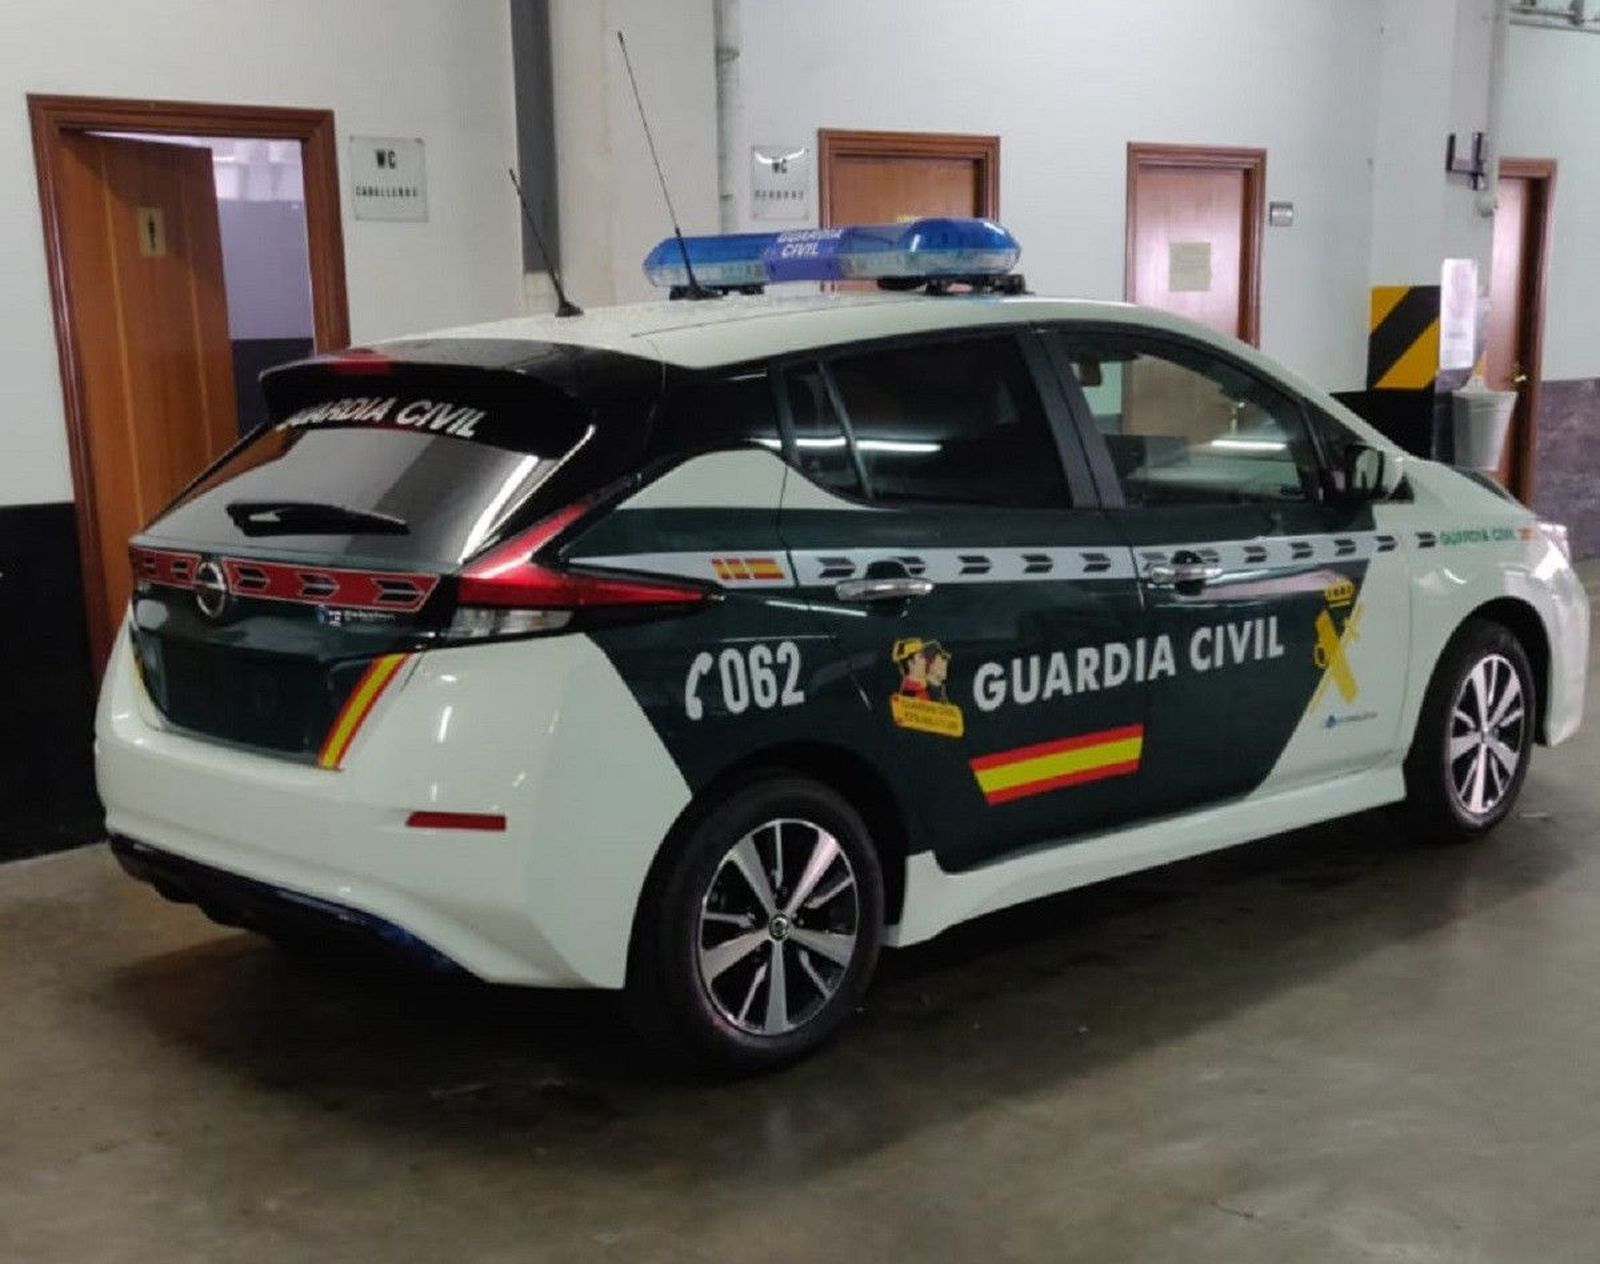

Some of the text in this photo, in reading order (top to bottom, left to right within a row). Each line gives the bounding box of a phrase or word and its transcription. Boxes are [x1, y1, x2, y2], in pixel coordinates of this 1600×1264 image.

[375, 149, 396, 169] WC
[771, 157, 787, 174] WC
[781, 242, 819, 258] CIVIL
[396, 400, 485, 438] CIVIL
[719, 641, 805, 714] 062
[973, 615, 1284, 712] GUARDIA CIVIL
